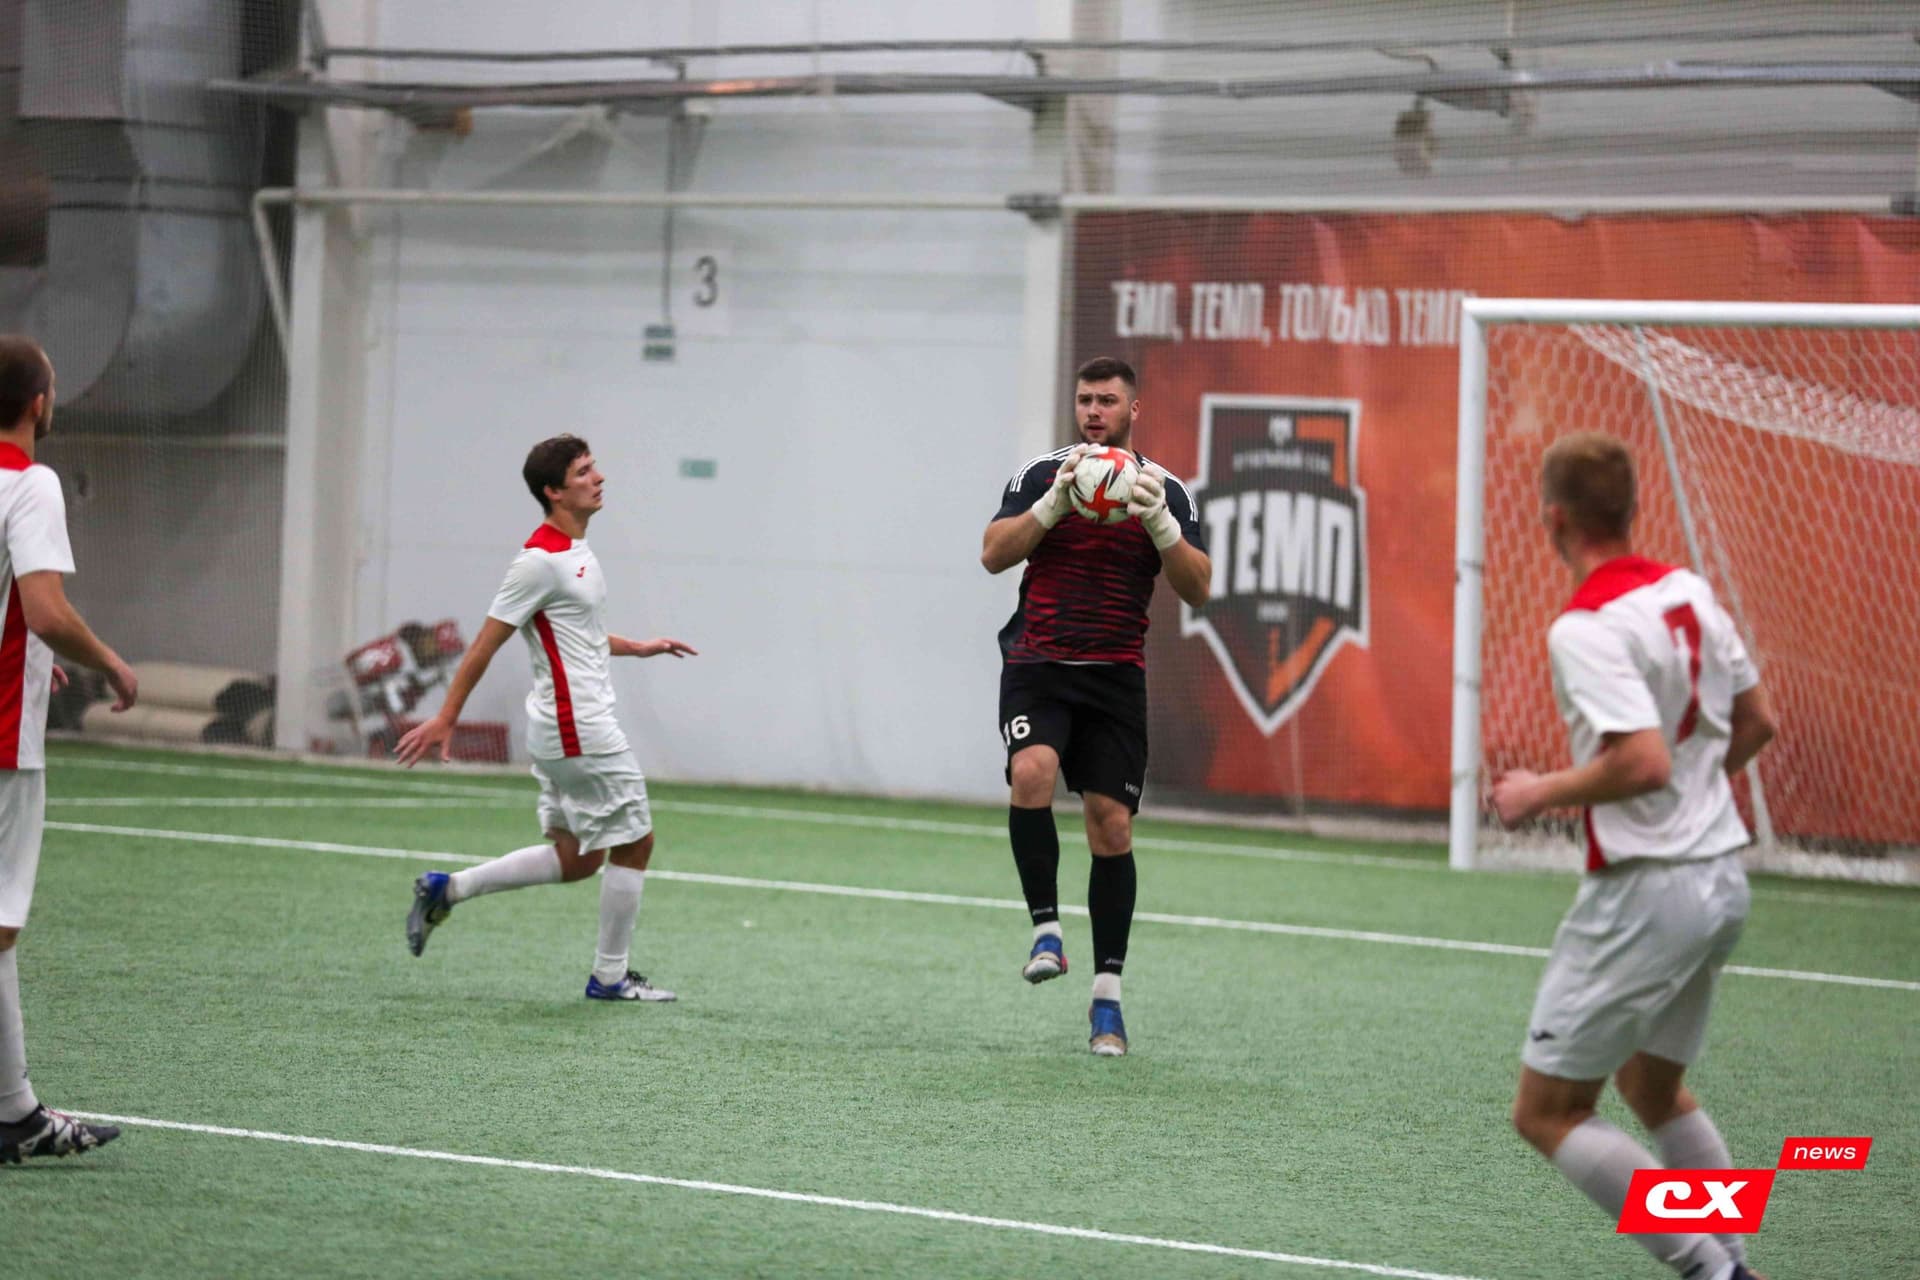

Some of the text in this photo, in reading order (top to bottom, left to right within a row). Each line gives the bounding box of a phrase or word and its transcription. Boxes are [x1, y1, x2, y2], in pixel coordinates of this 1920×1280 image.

[693, 255, 718, 308] 3
[1191, 282, 1271, 347] ТЕМП,
[1279, 284, 1391, 345] ТОЛЬКО
[1205, 489, 1356, 609] ТЕМП
[1662, 602, 1703, 745] 7
